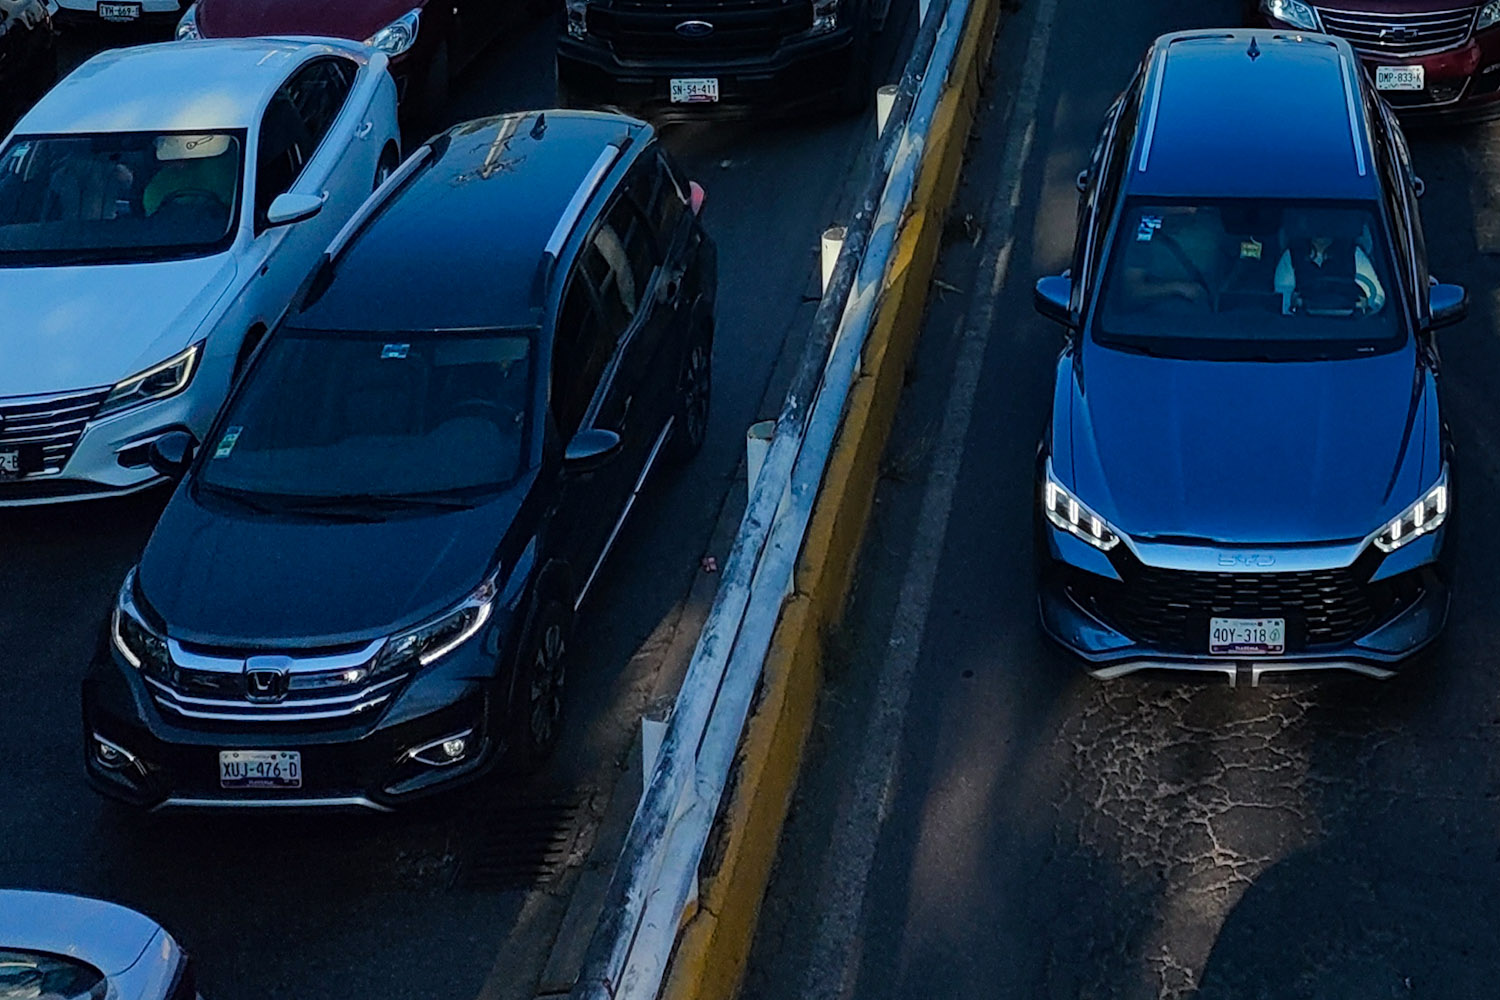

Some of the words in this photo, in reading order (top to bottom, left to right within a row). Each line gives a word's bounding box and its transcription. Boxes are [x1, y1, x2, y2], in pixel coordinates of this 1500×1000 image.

[1217, 553, 1276, 567] BYD
[1213, 628, 1267, 642] 40Y-318
[223, 762, 297, 777] XUJ-476-D
